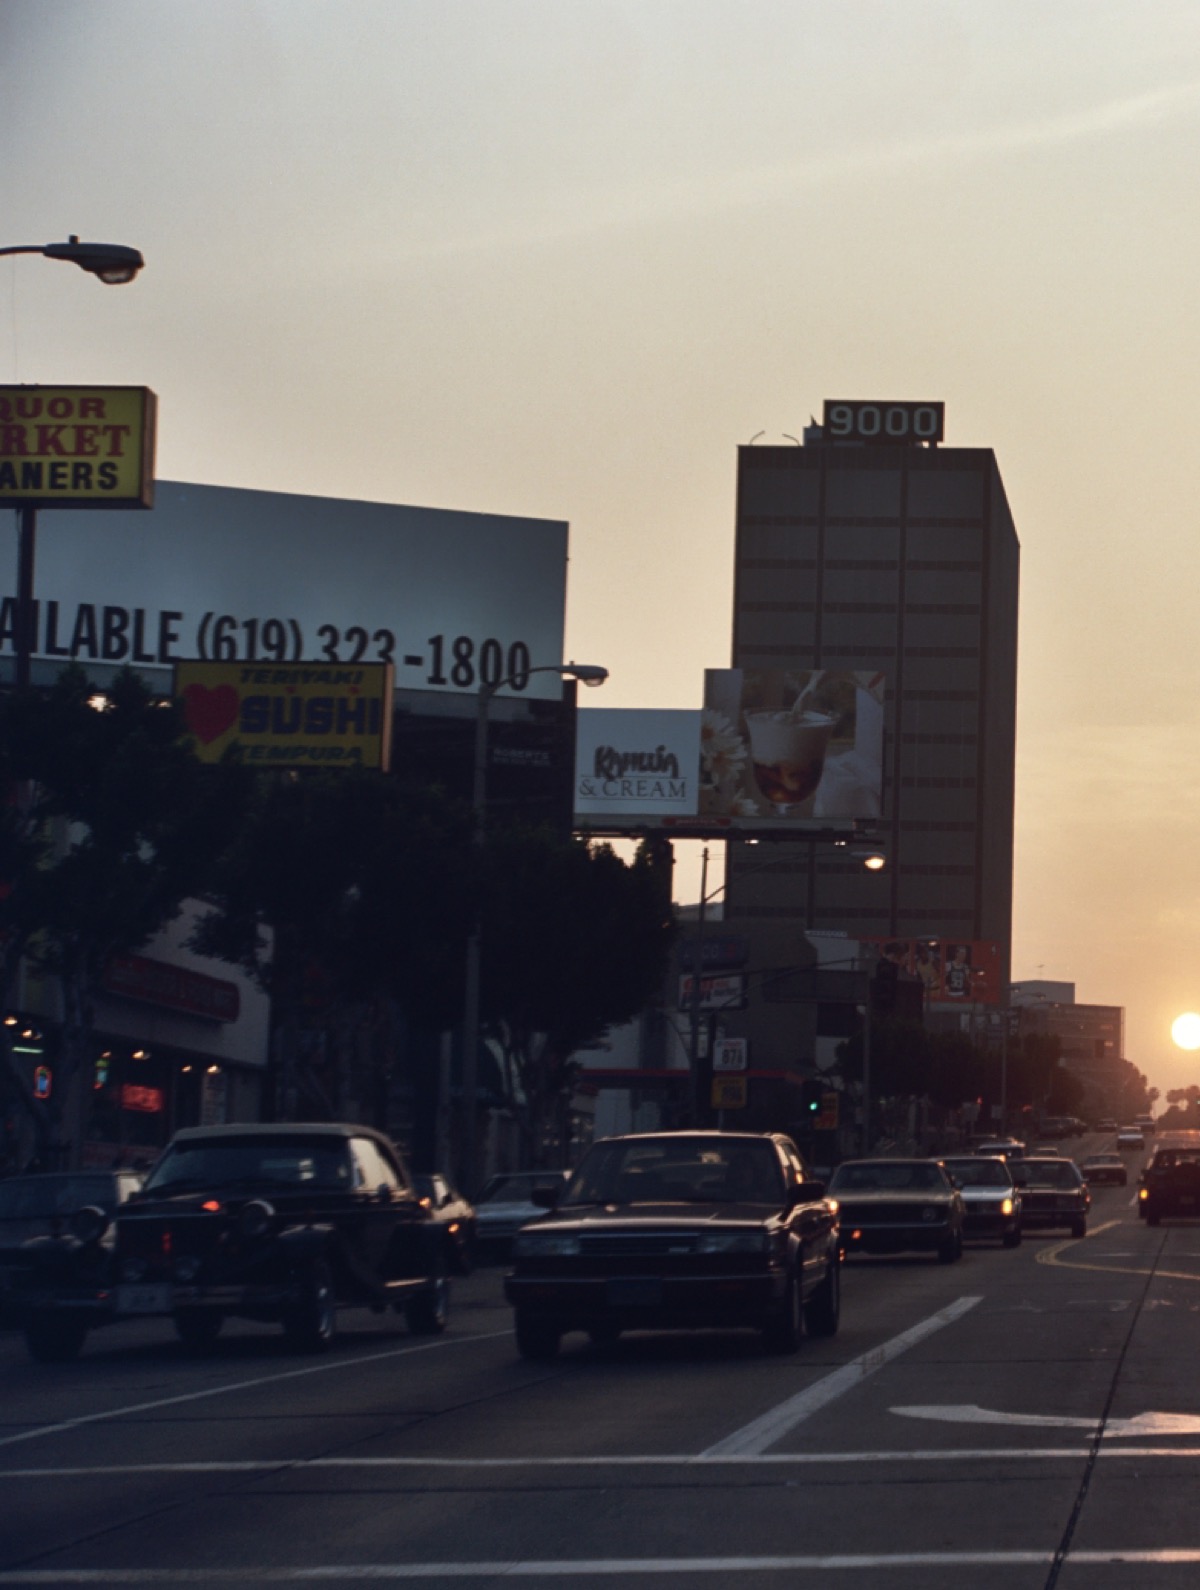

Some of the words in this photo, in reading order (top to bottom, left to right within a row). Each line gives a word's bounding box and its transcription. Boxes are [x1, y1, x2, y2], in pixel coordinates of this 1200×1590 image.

[829, 406, 939, 436] 9000
[197, 610, 304, 662] (619)
[240, 668, 364, 684] TERIYAKI
[240, 695, 380, 735] SUSHI
[579, 779, 595, 797] &
[602, 779, 687, 798] CREAM
